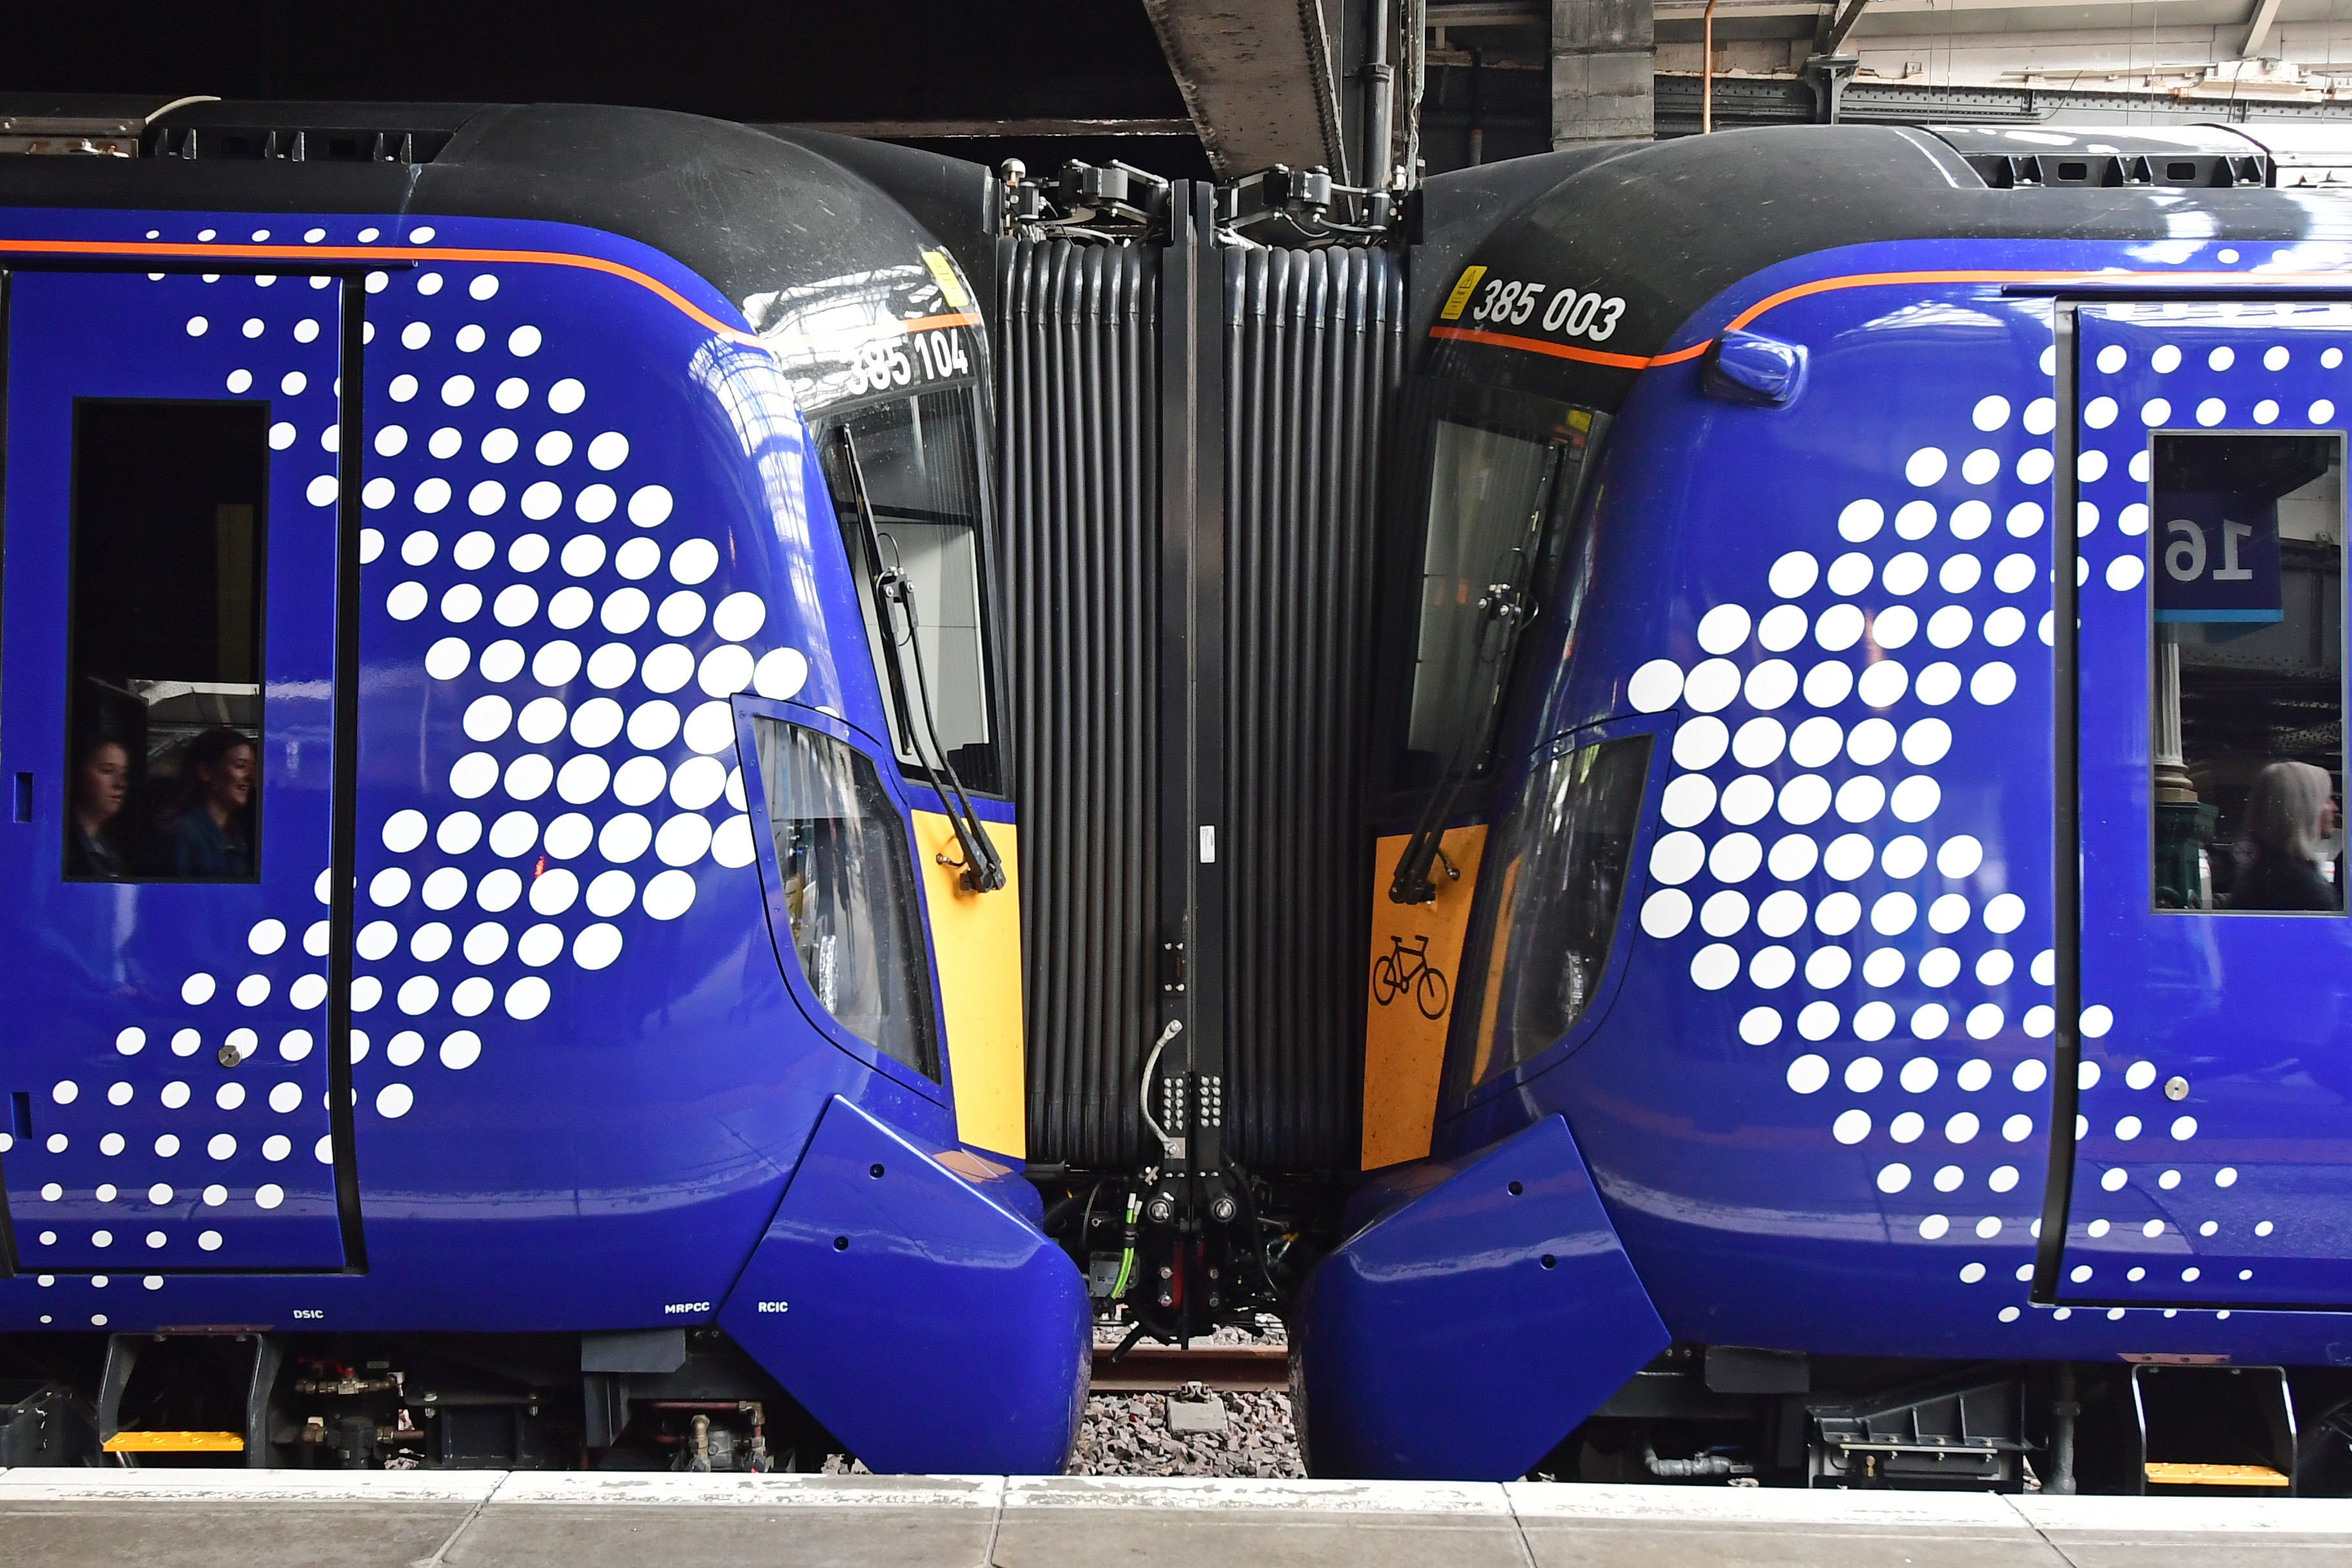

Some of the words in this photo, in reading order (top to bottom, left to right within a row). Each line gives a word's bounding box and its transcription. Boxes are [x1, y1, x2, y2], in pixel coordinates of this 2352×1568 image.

[1473, 279, 1546, 326] 385
[1542, 288, 1626, 341] 003
[847, 337, 911, 395] 385
[914, 329, 968, 380] 104
[665, 1302, 710, 1314] MRPCC
[758, 1302, 789, 1313] RCIC
[293, 1309, 324, 1319] DSIC
